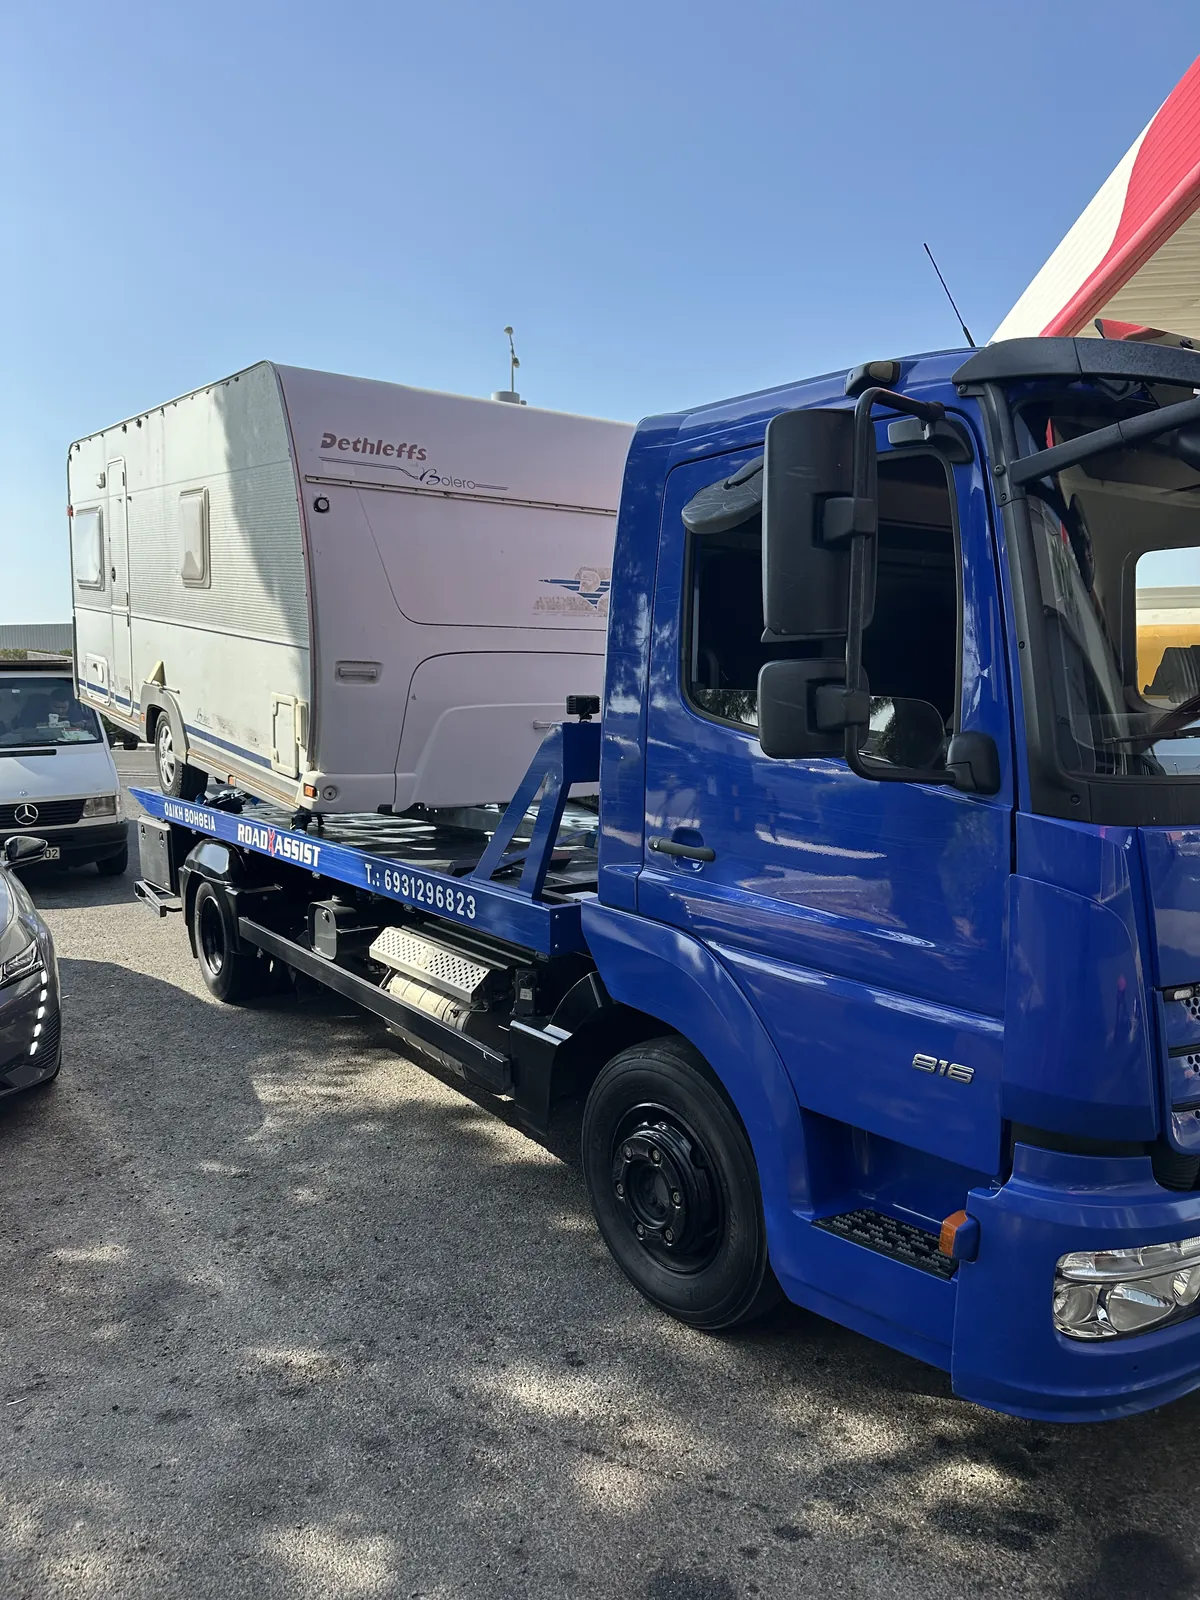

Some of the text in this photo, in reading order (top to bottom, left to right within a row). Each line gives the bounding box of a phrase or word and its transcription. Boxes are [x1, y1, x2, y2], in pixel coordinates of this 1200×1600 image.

[320, 432, 428, 461] Dethleffs
[418, 466, 477, 490] Bolero
[164, 802, 216, 832] ΟΔΙΚΗ ΒΟΗΘΕΙΑ
[384, 869, 476, 920] 6931296823
[911, 1053, 975, 1084] 816
